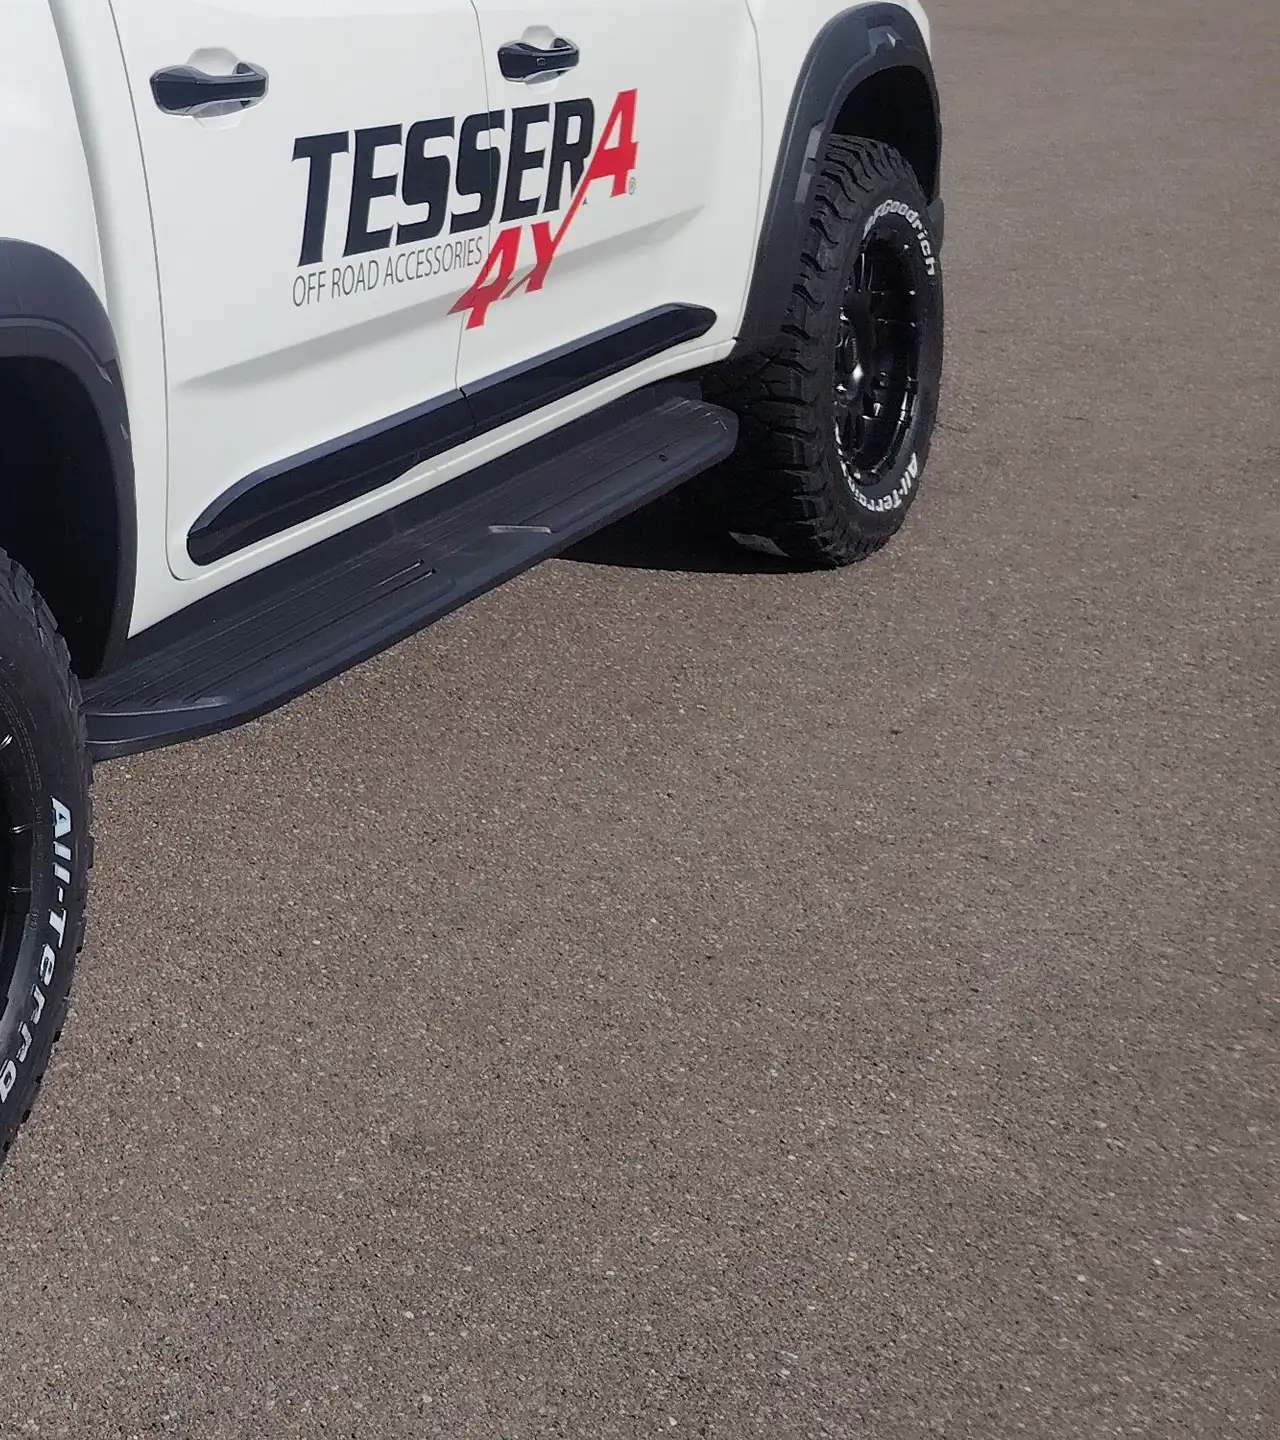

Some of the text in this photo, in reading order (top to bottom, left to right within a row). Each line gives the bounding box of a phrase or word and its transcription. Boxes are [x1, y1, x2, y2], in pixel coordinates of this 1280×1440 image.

[292, 235, 483, 308] OFF ROAD ACCESSORIES
